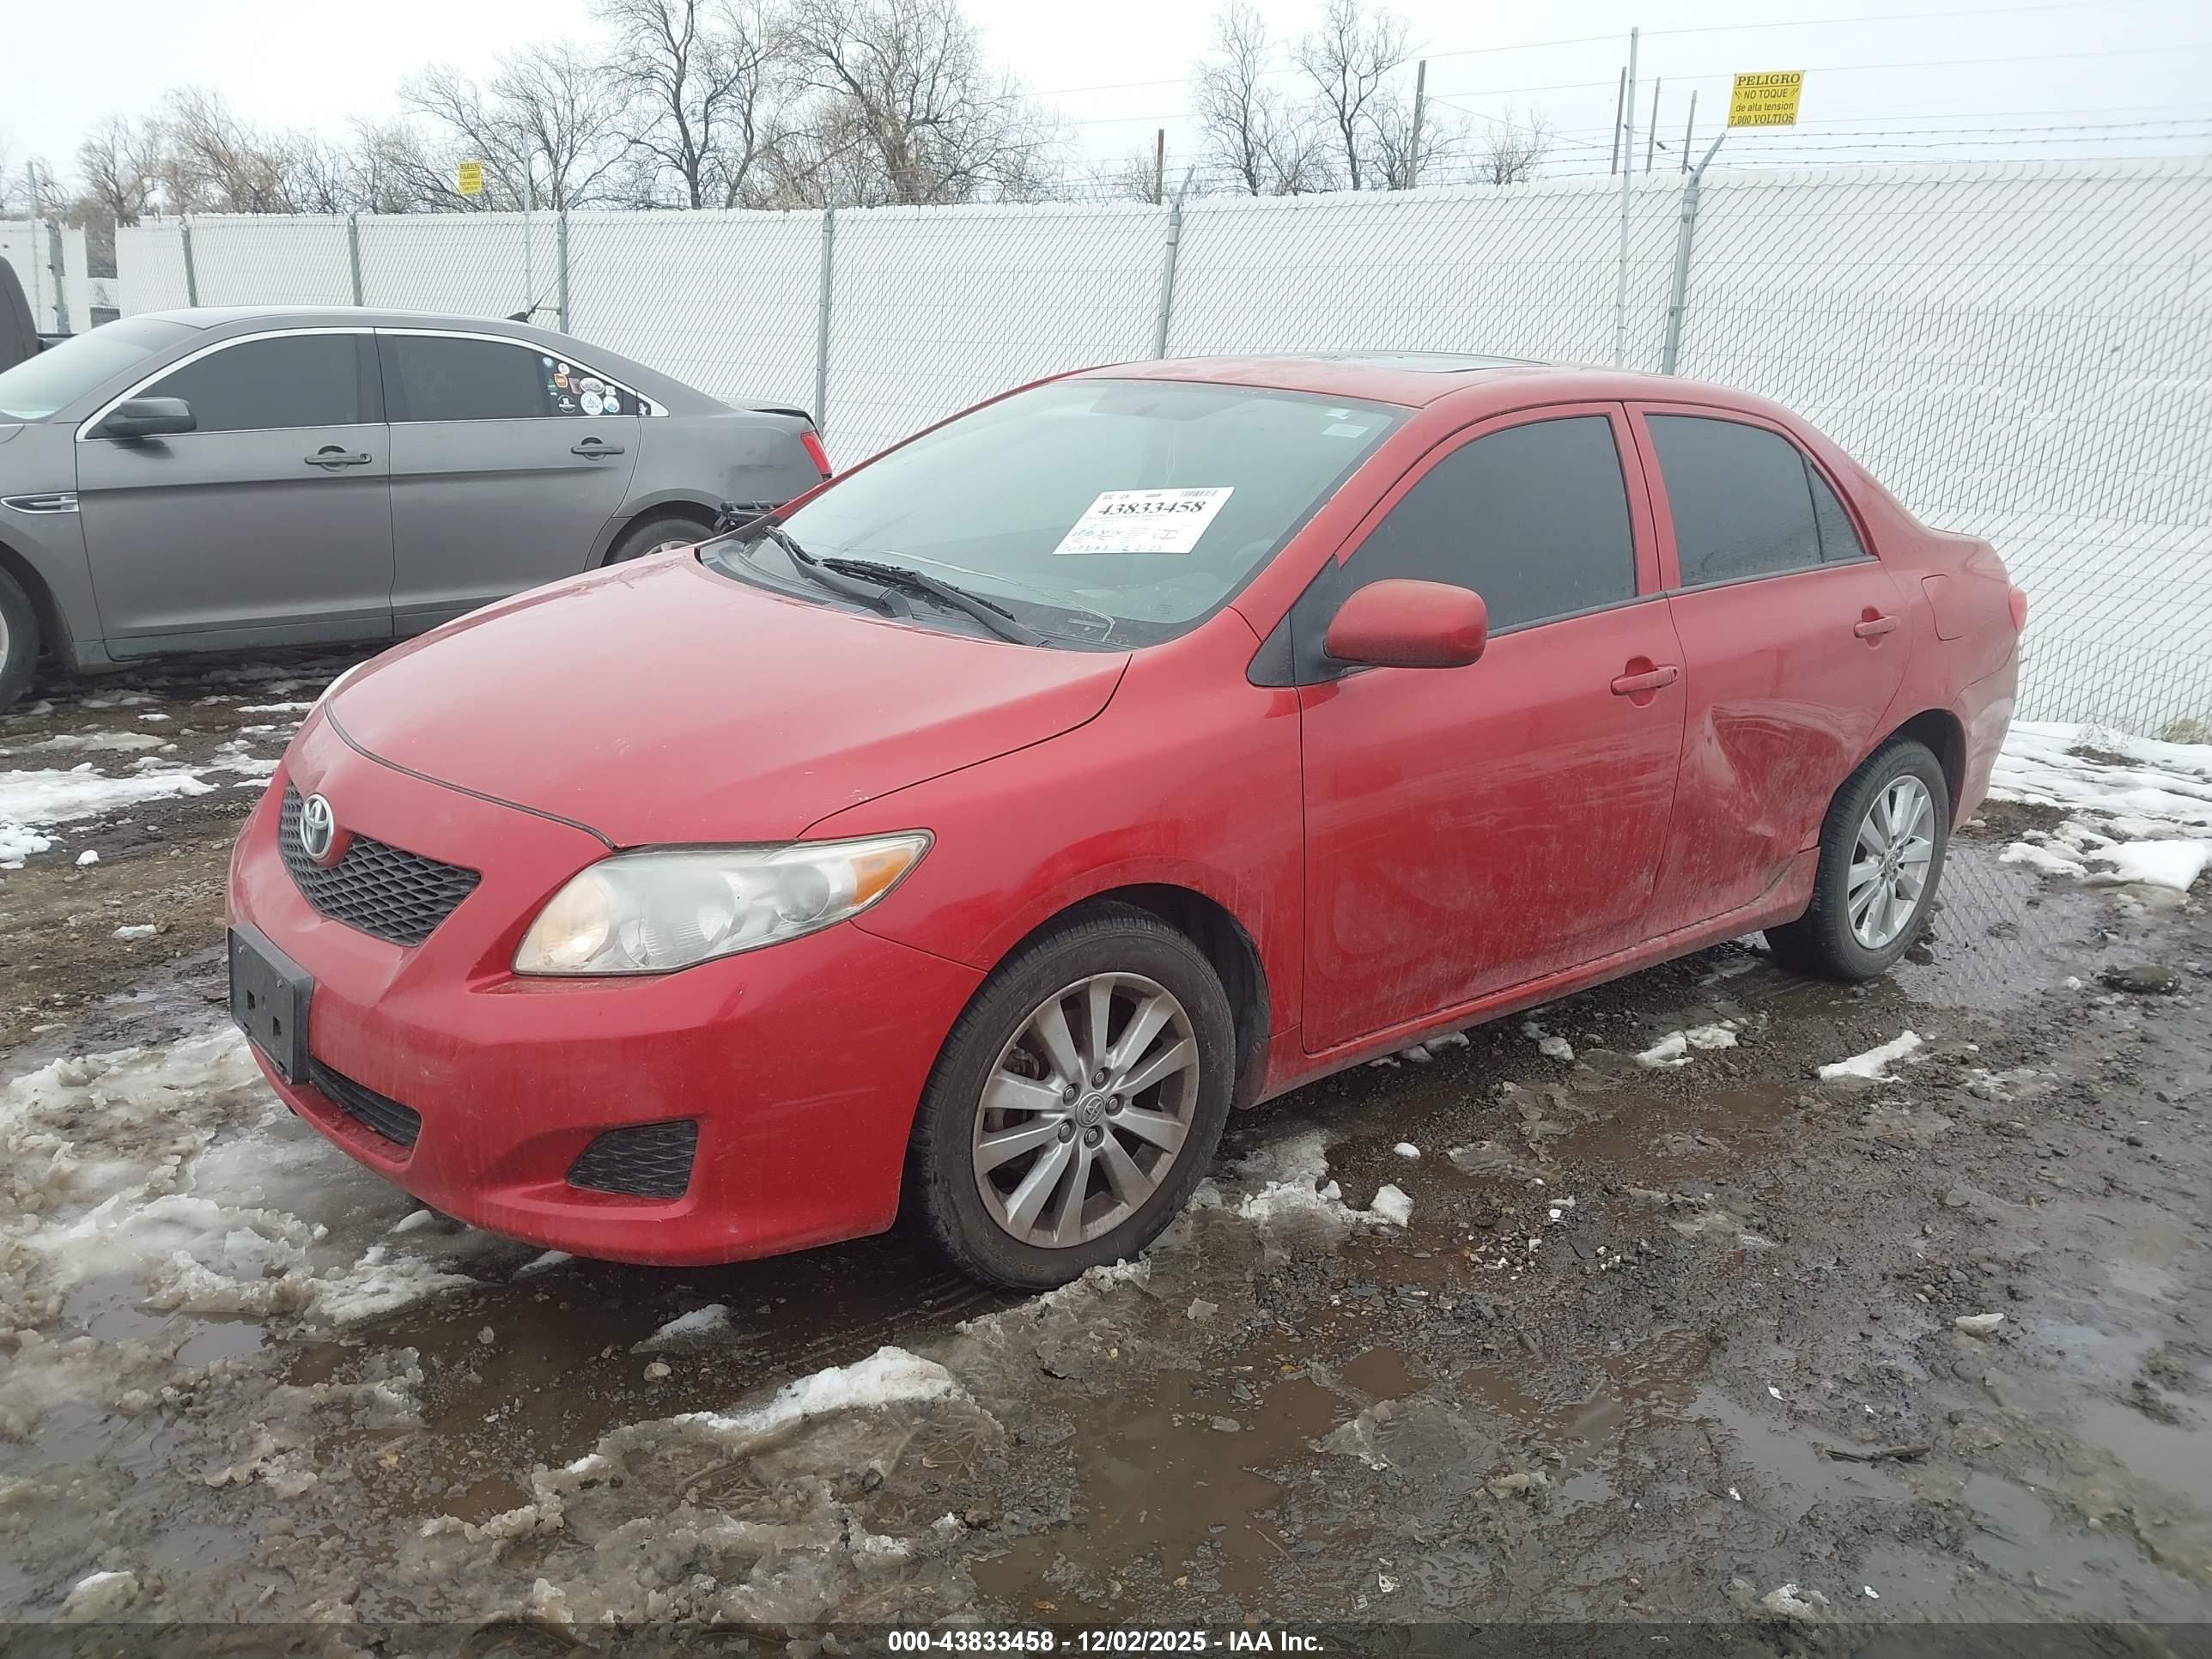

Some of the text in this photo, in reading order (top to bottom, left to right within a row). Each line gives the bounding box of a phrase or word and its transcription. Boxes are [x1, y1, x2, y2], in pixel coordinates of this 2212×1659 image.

[1737, 73, 1801, 86] PELIGRO
[1744, 88, 1788, 99] NO TOQUE
[1735, 100, 1794, 112] de alta tension
[1753, 112, 1795, 125] VOLTIOS
[1099, 501, 1206, 515] 43833458
